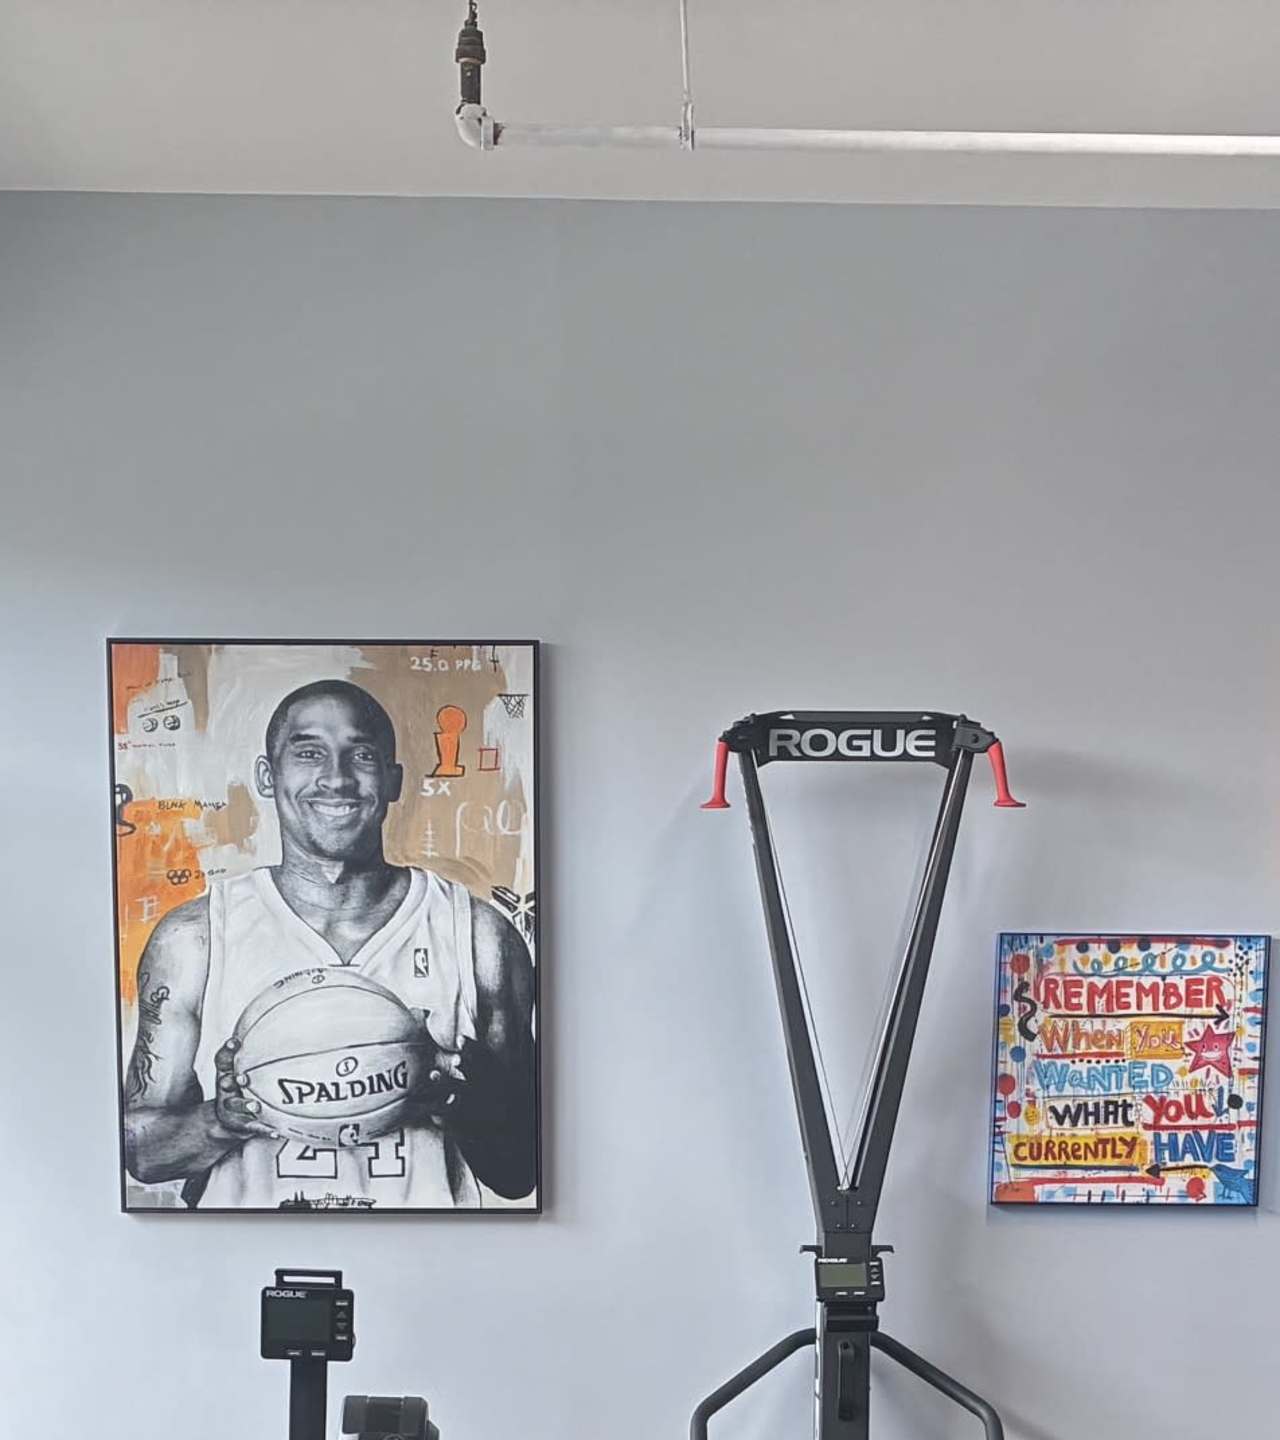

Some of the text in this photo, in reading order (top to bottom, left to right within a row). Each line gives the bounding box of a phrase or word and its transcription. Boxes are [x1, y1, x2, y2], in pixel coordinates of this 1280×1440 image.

[769, 728, 937, 758] ROGUE
[1040, 975, 1228, 1013] REMEMBER
[277, 1060, 409, 1105] SPALDING
[1153, 1131, 1236, 1163] HAVE
[265, 1289, 308, 1299] ROGUE
